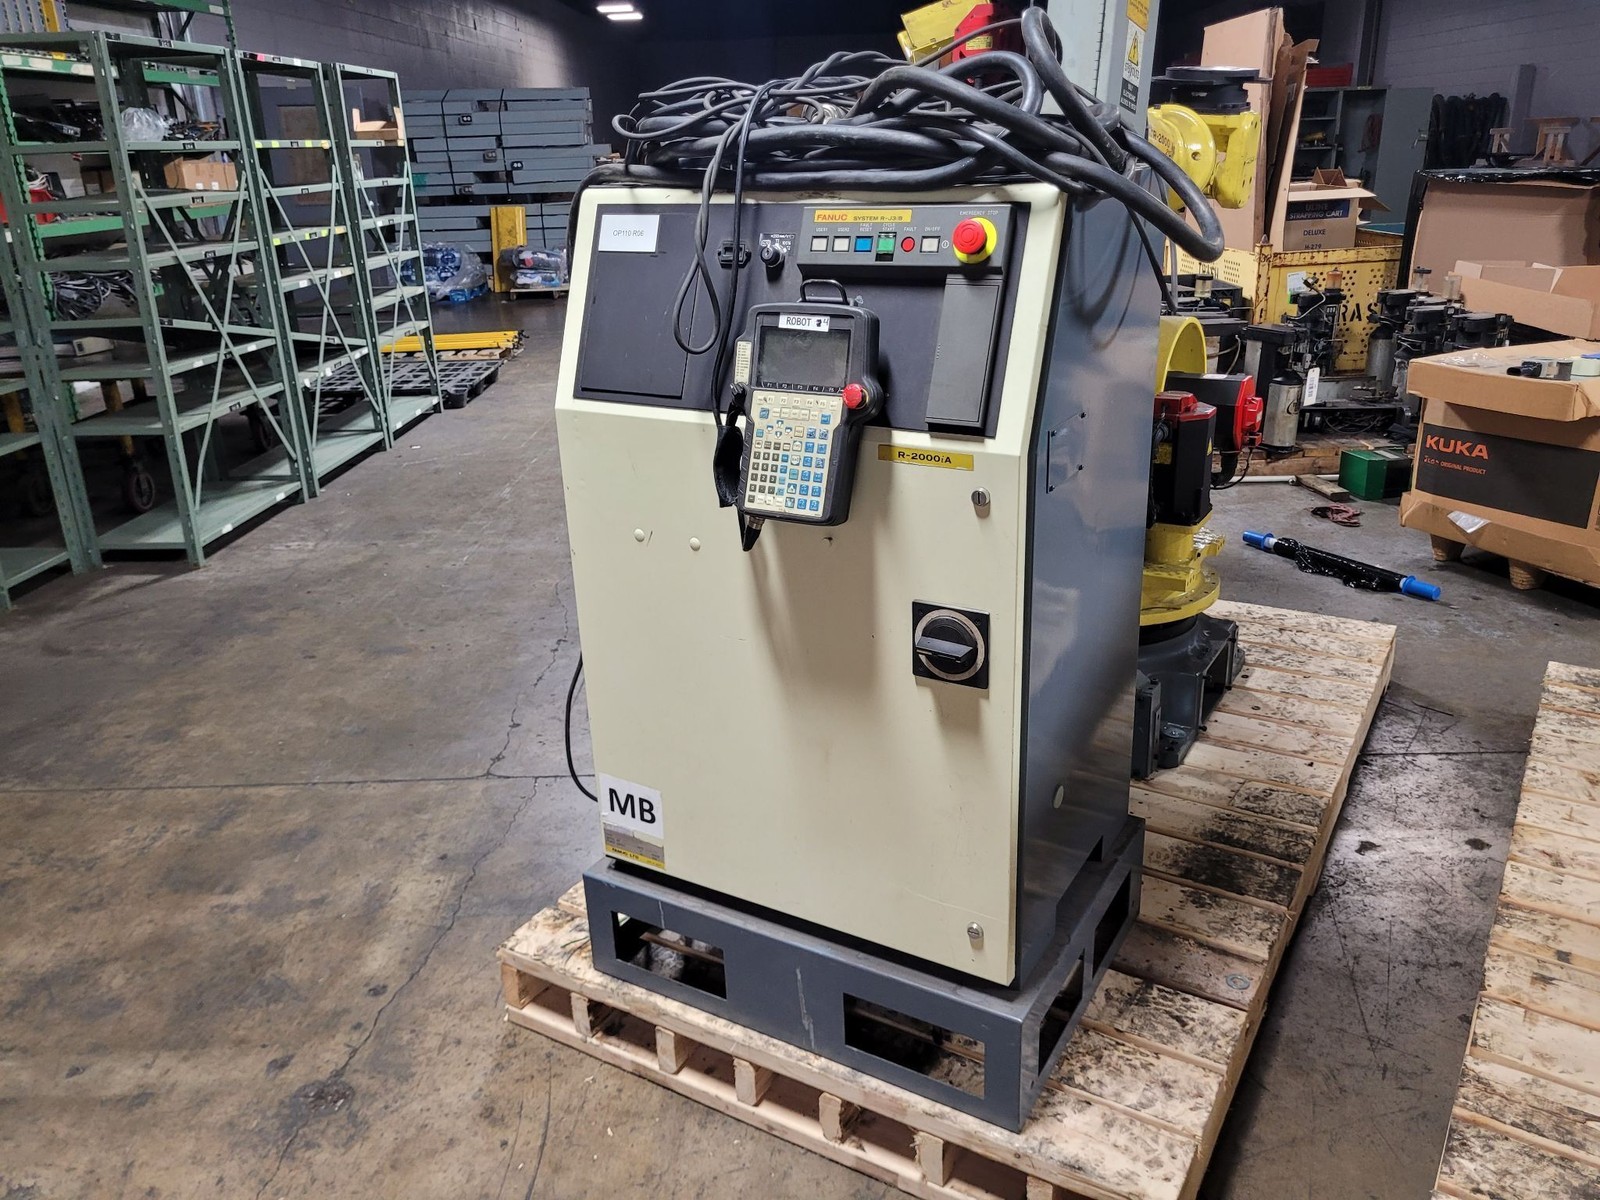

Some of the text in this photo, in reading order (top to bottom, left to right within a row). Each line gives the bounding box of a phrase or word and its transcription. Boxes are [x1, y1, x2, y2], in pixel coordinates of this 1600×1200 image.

[1326, 209, 1343, 217] CART
[1303, 228, 1326, 236] DELUXE
[1337, 302, 1378, 322] RAS
[786, 316, 812, 327] ROBOT
[1425, 434, 1489, 460] KUKA
[897, 451, 952, 464] R-2000iA
[1440, 461, 1486, 475] ORIGINAL PRODUCT
[609, 788, 656, 824] MB
